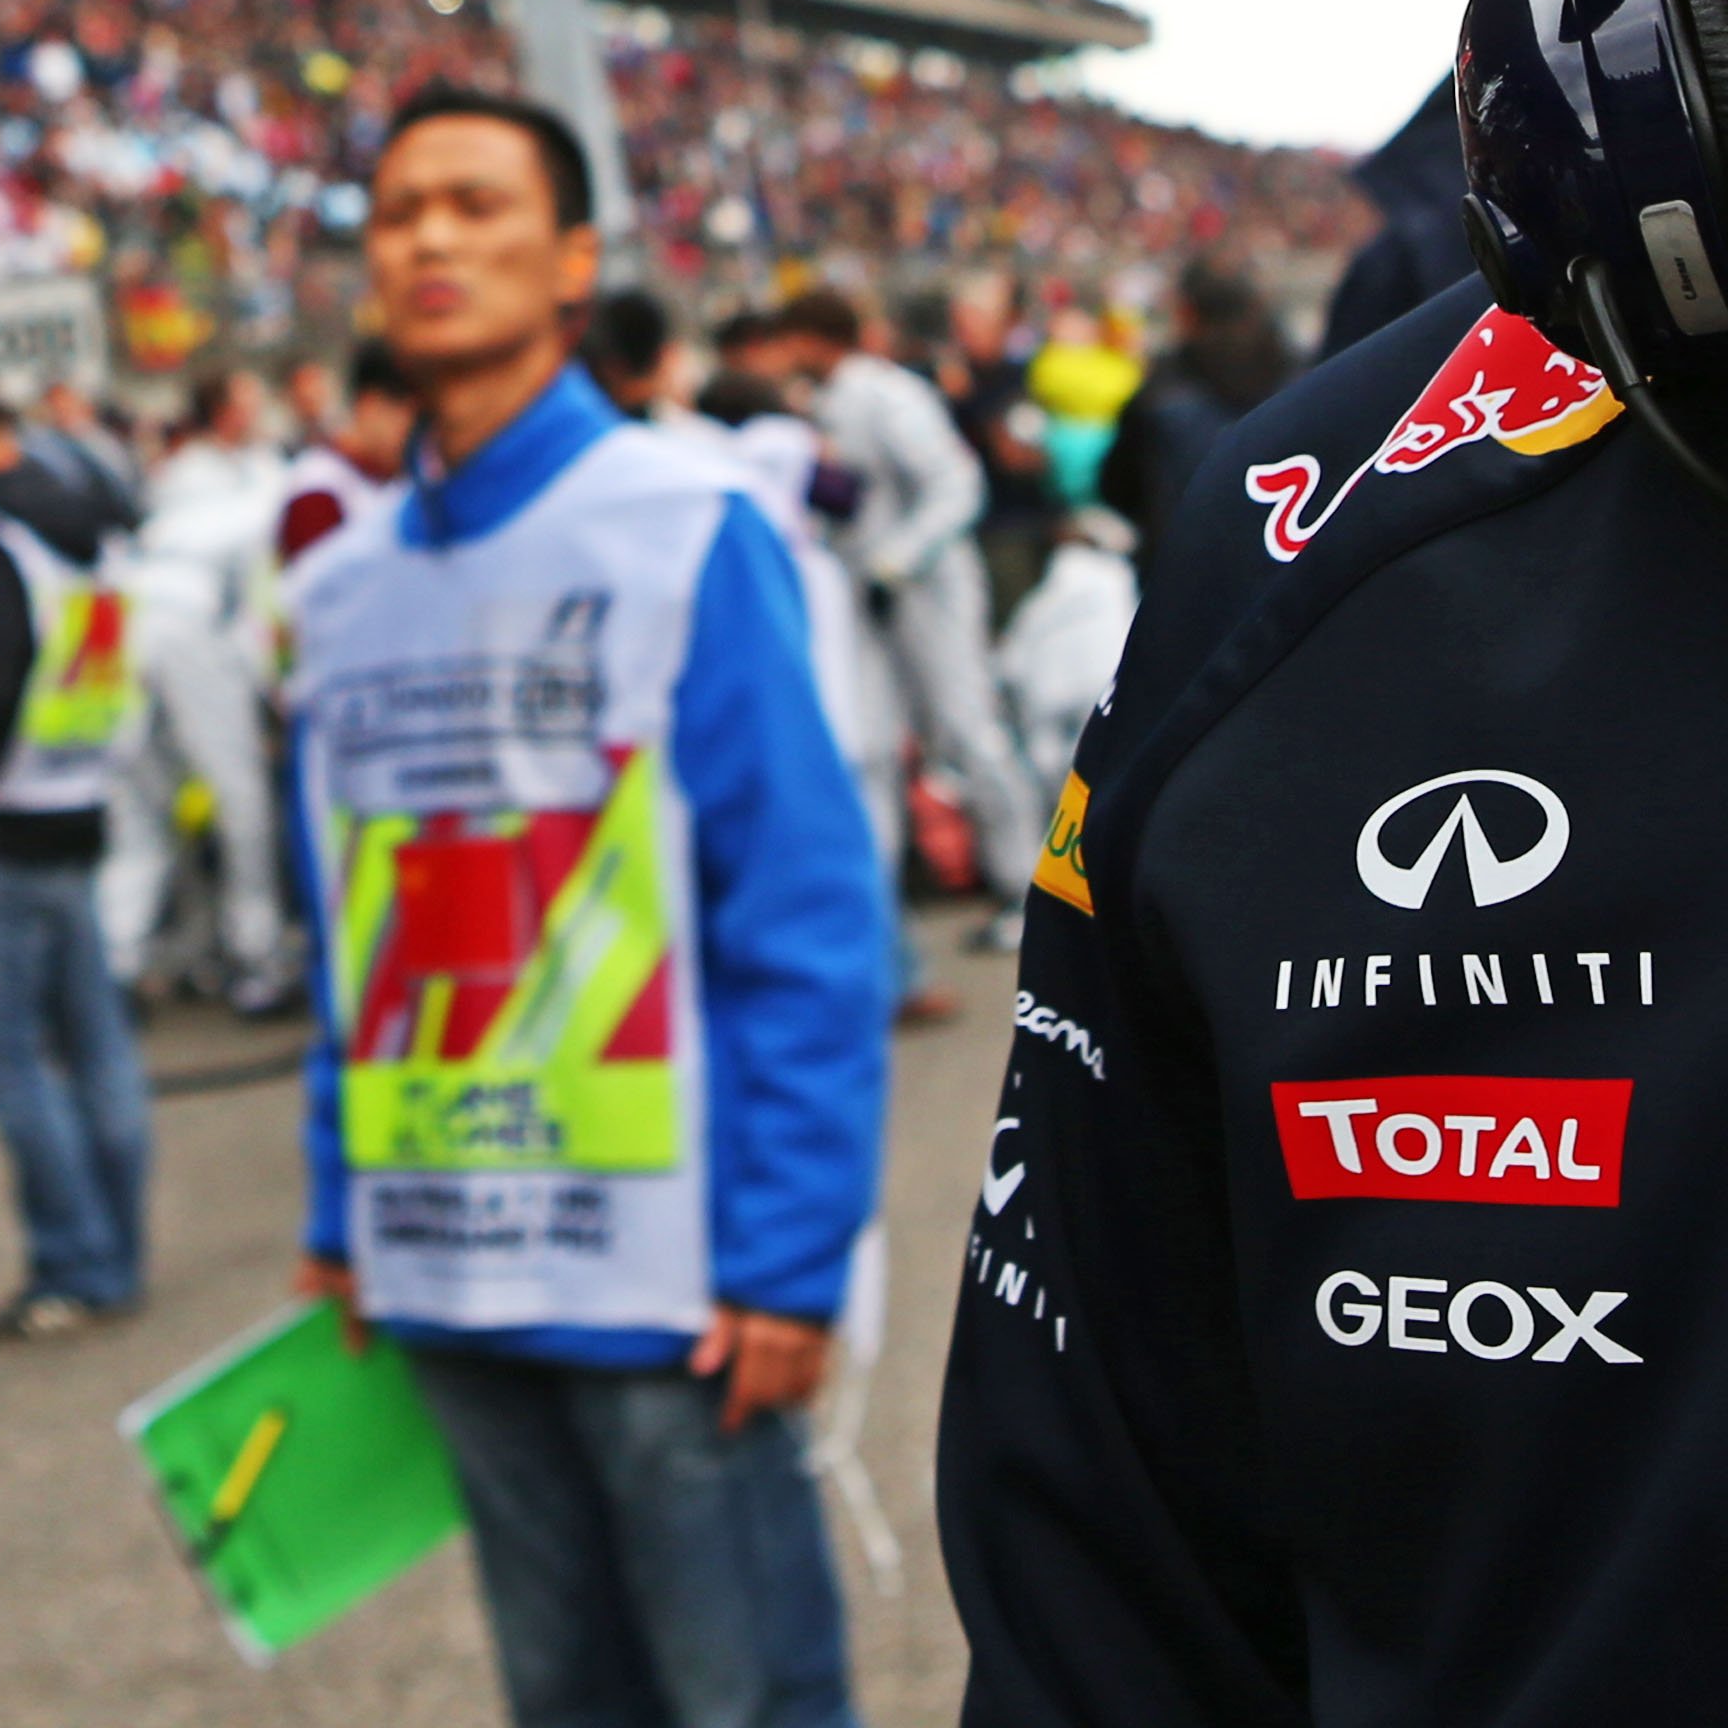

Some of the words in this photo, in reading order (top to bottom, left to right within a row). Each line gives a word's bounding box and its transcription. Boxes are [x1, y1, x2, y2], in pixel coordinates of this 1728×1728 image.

[1275, 951, 1654, 1010] INFINITI
[1298, 1098, 1601, 1181] TOTAL
[1315, 1270, 1644, 1364] GEOX
